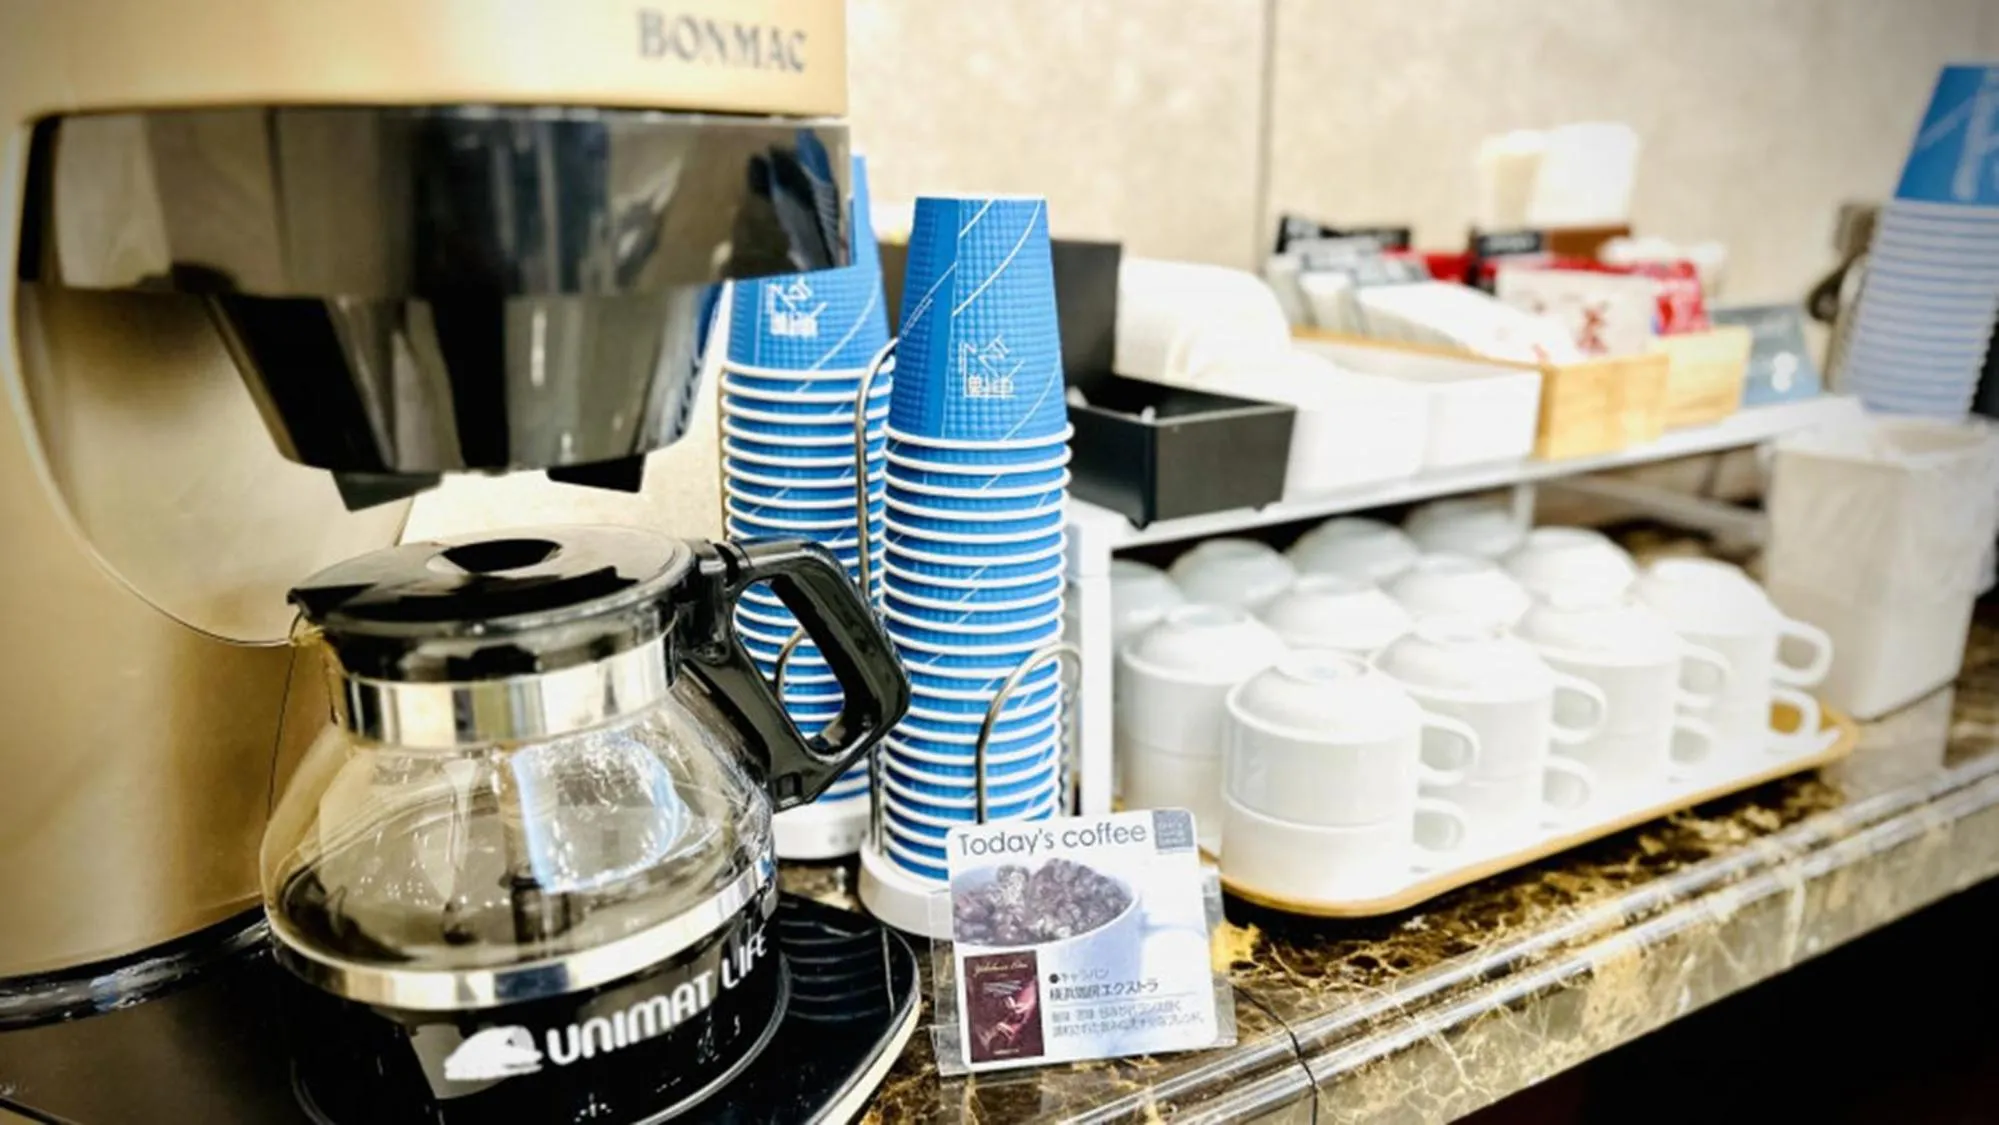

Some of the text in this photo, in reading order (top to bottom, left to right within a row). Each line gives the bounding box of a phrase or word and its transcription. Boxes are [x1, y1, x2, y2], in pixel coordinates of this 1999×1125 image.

[637, 9, 806, 73] BONMAC
[958, 829, 1054, 856] Today's
[1062, 822, 1147, 848] coffee
[546, 924, 767, 1065] UNIMAT LIFE
